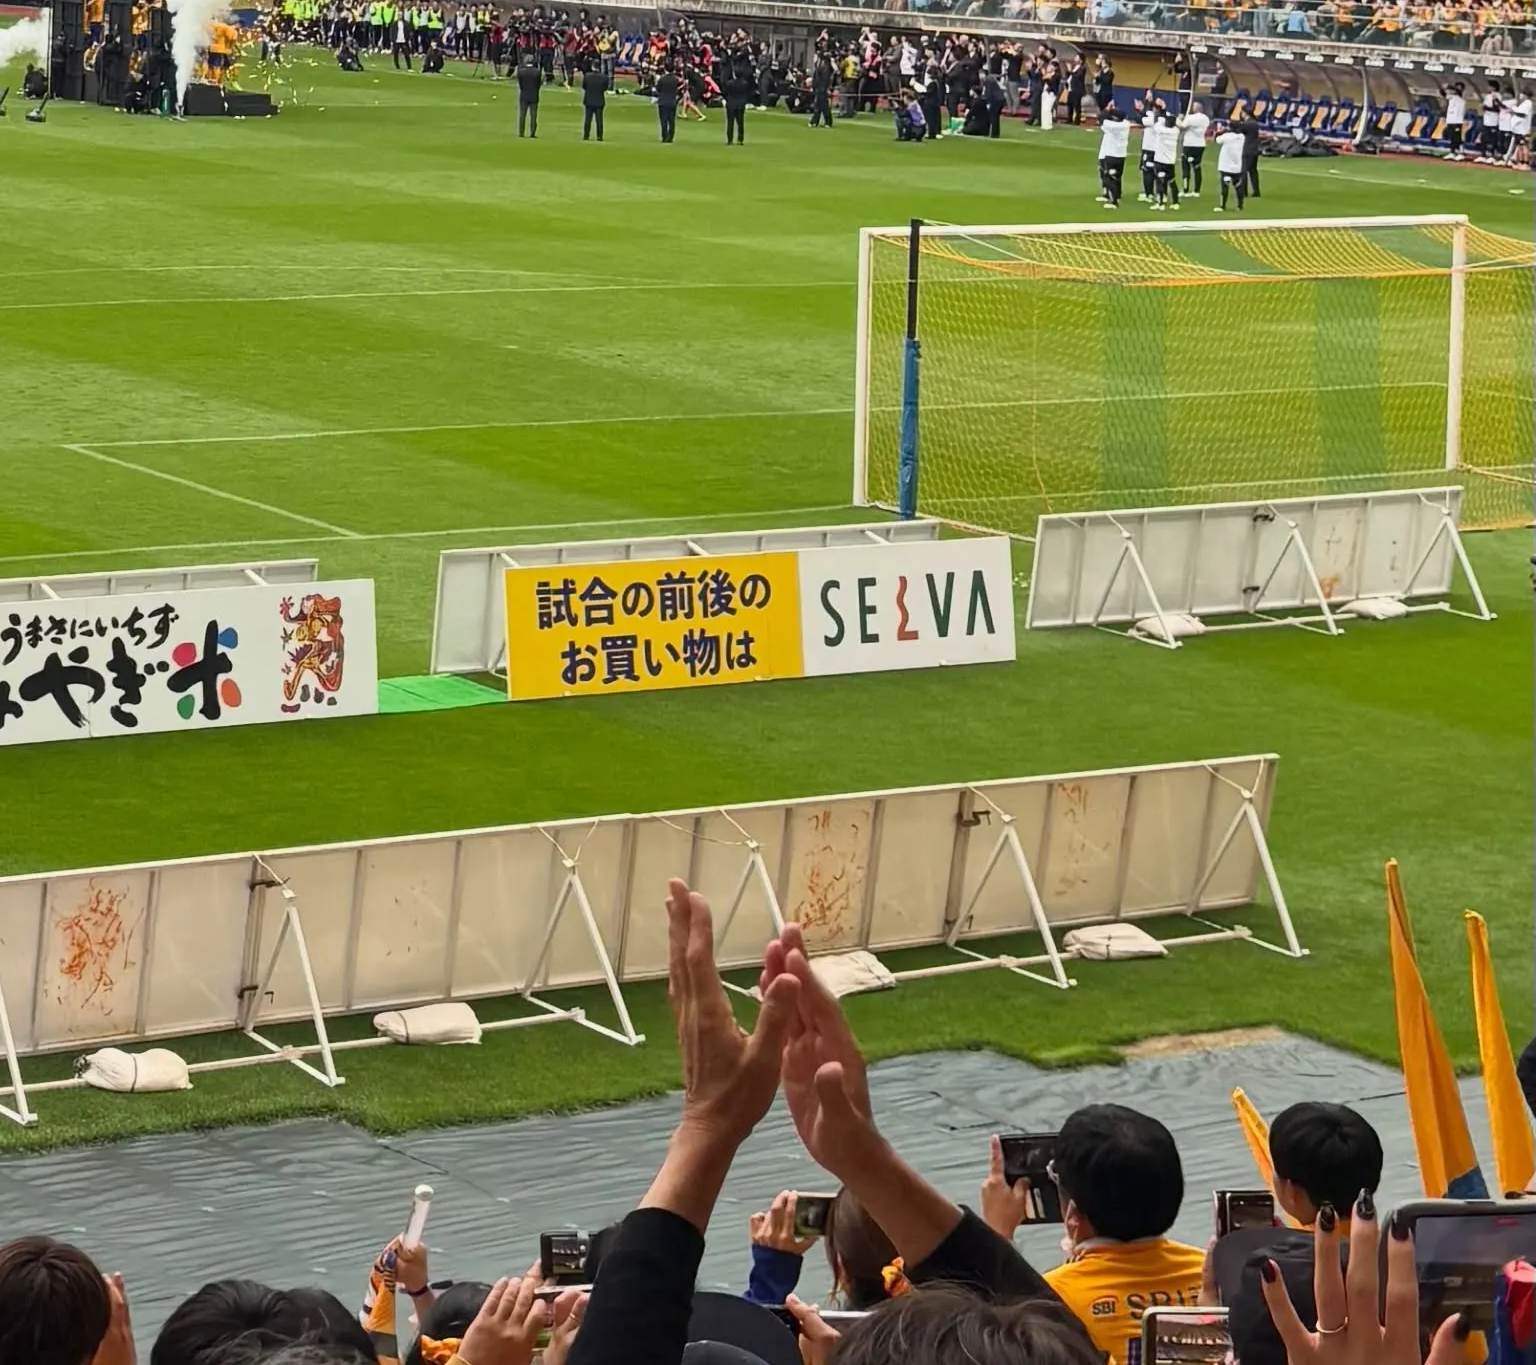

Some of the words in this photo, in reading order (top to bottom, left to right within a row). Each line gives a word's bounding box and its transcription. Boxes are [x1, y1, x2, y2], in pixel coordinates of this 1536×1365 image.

[535, 568, 771, 631] 試合の前後の
[820, 569, 996, 648] SELVA
[0, 601, 178, 666] うまさにいちず
[559, 628, 757, 686] お買い物は
[1092, 1301, 1116, 1315] SBI
